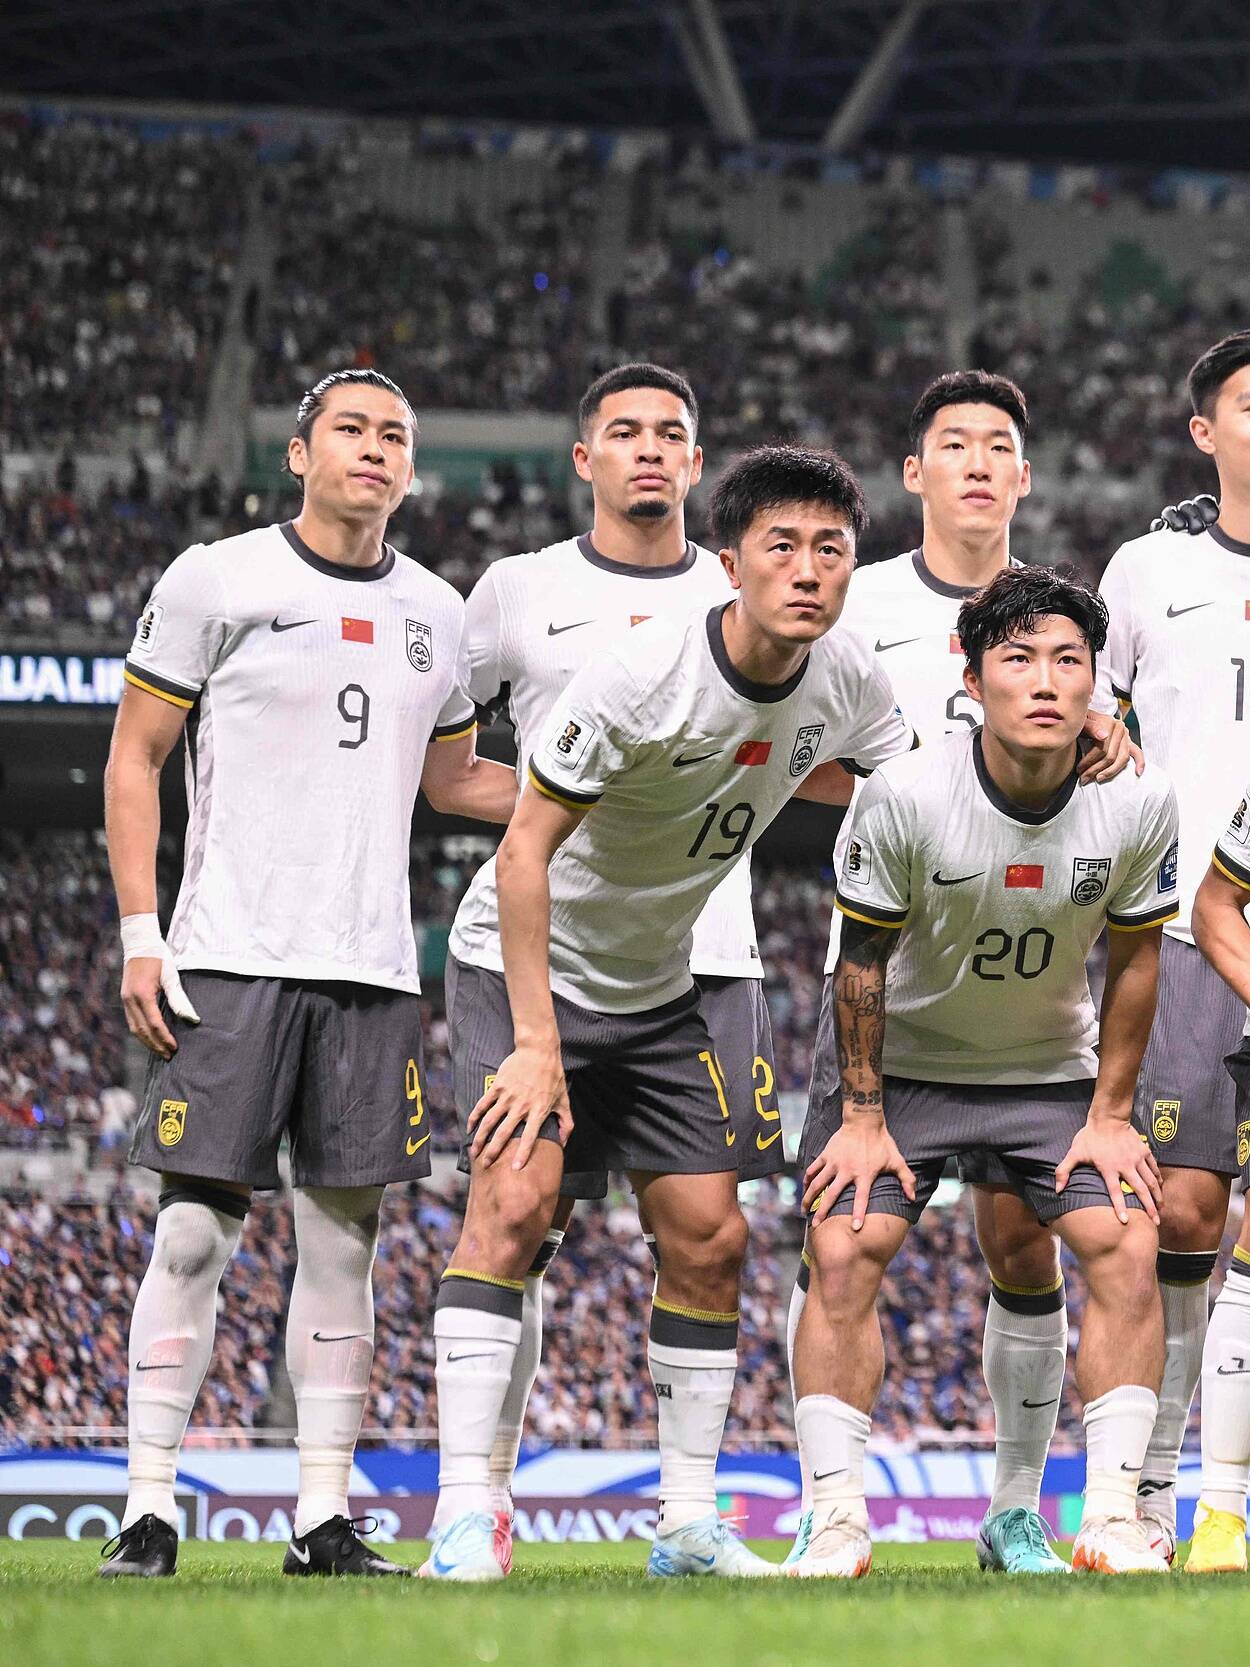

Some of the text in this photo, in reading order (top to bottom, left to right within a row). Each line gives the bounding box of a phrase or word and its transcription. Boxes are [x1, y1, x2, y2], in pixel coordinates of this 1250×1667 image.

[408, 622, 430, 638] CFA
[337, 683, 370, 750] 9
[799, 728, 821, 740] CFA
[687, 802, 756, 861] 19
[1077, 861, 1108, 872] CFA
[971, 927, 1055, 981] 20
[405, 1058, 424, 1127] 9
[698, 1050, 730, 1119] 1
[751, 1055, 780, 1121] 2
[1156, 1102, 1178, 1111] CFA
[428, 1508, 662, 1543] WAYS
